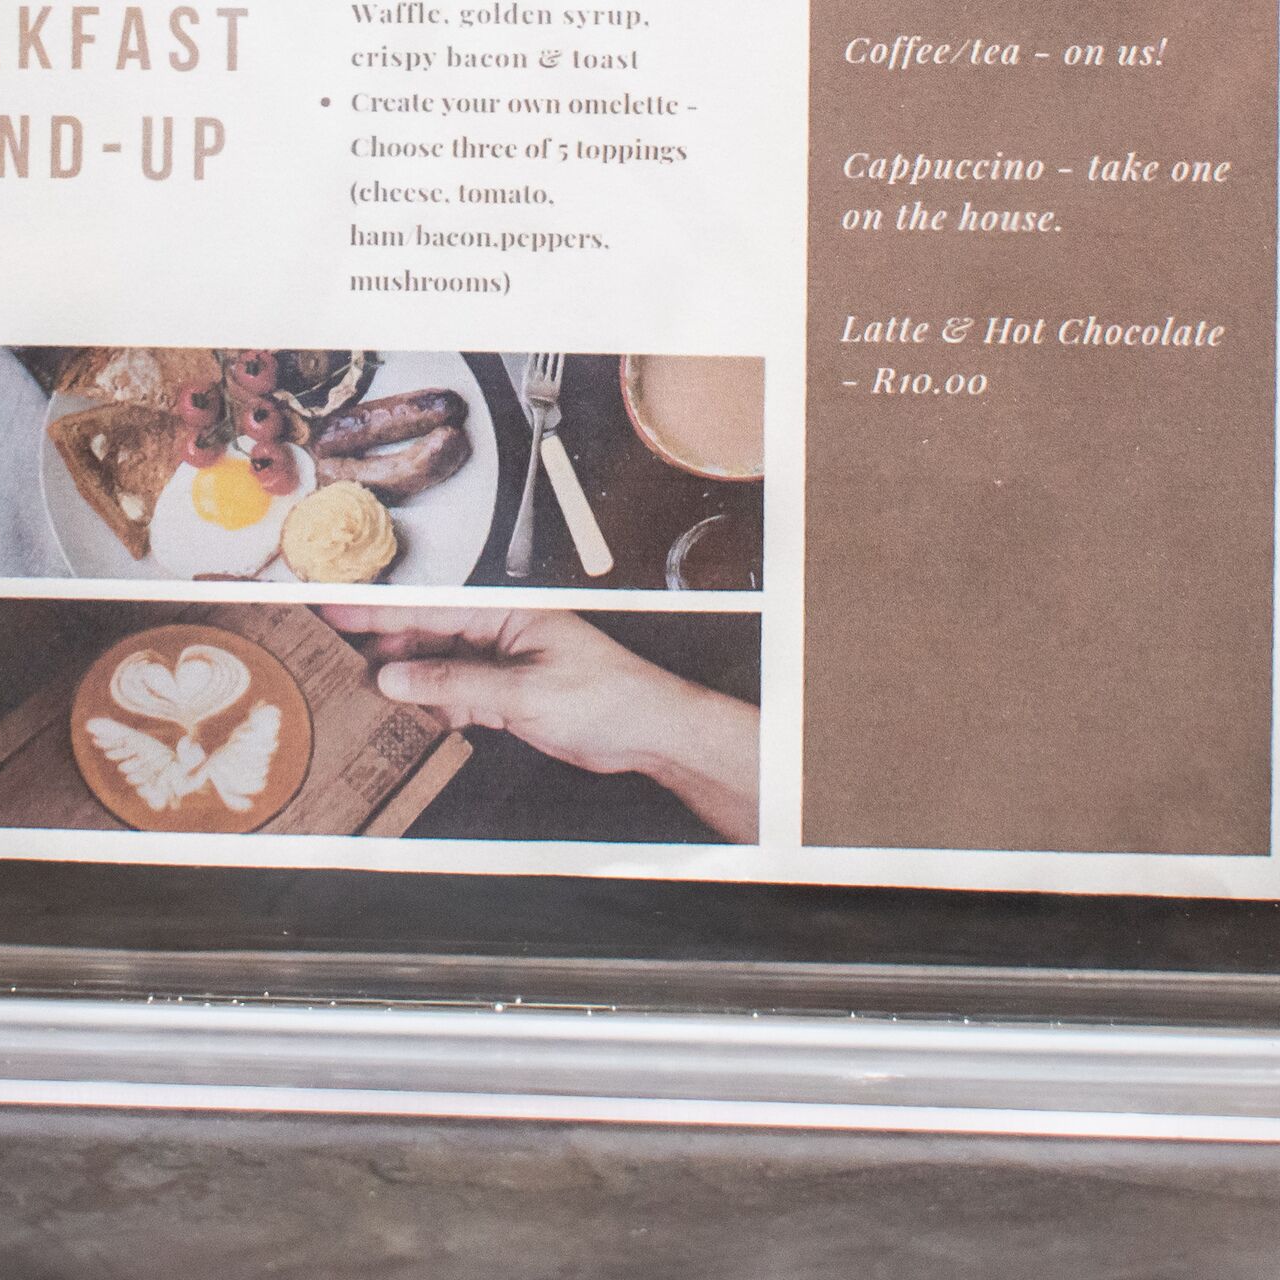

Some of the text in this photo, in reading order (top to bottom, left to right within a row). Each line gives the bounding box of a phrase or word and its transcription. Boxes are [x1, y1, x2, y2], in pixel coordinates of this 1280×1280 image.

[460, 2, 552, 28] golden
[351, 45, 639, 71] crispy bacon & toast
[845, 35, 1020, 70] Coffee/tea
[1064, 44, 1104, 65] on
[1118, 38, 1168, 66] us!
[352, 92, 434, 114] Create
[442, 97, 501, 116] your
[508, 97, 560, 114] own
[568, 93, 679, 116] omelette
[351, 136, 687, 164] Choose three of 5 toppings
[843, 151, 1045, 186] Cappuccino
[1088, 152, 1159, 182] take
[1170, 162, 1231, 184] one
[842, 201, 1062, 232] on the house.
[350, 270, 511, 295] mushrooms)
[839, 316, 1225, 347] Latte & Hot Chocolate
[871, 368, 987, 395] R10.00
